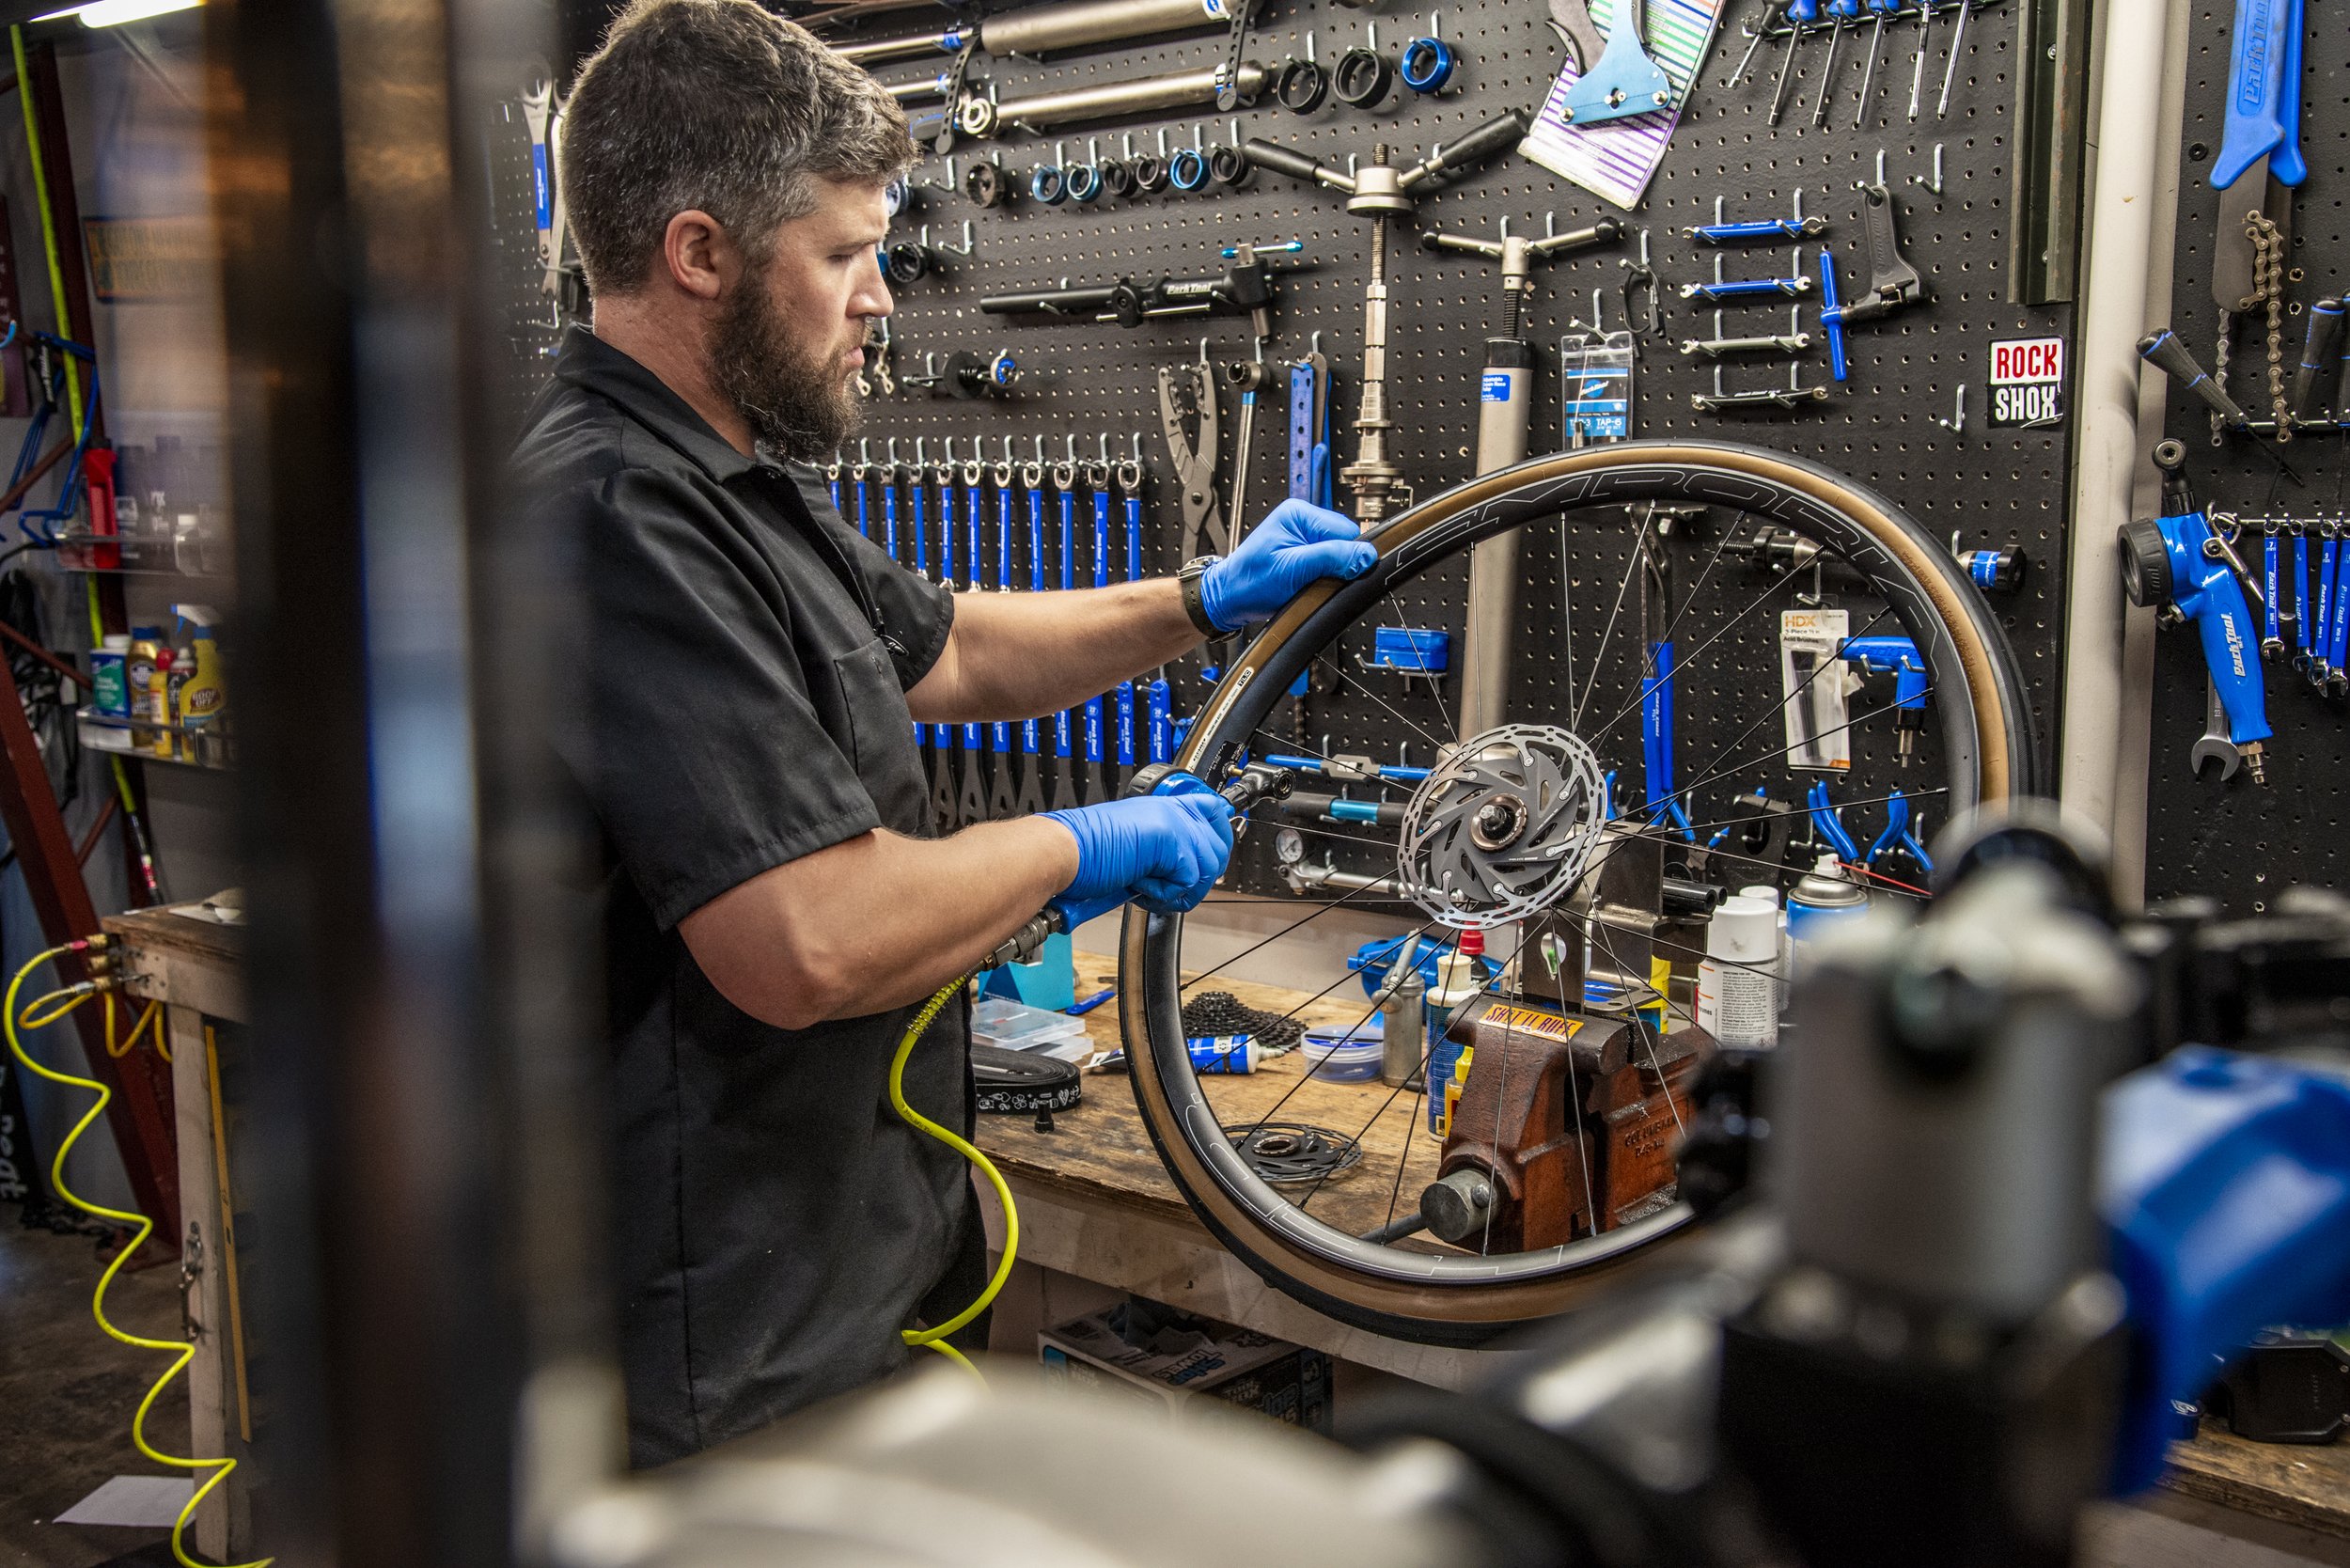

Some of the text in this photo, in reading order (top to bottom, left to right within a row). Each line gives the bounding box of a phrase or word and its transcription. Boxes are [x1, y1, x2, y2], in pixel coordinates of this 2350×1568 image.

[1997, 344, 2058, 379] ROCK
[1995, 385, 2057, 421] SHOX
[1785, 615, 1816, 627] HDX
[1152, 1348, 1223, 1381] TOWELS
